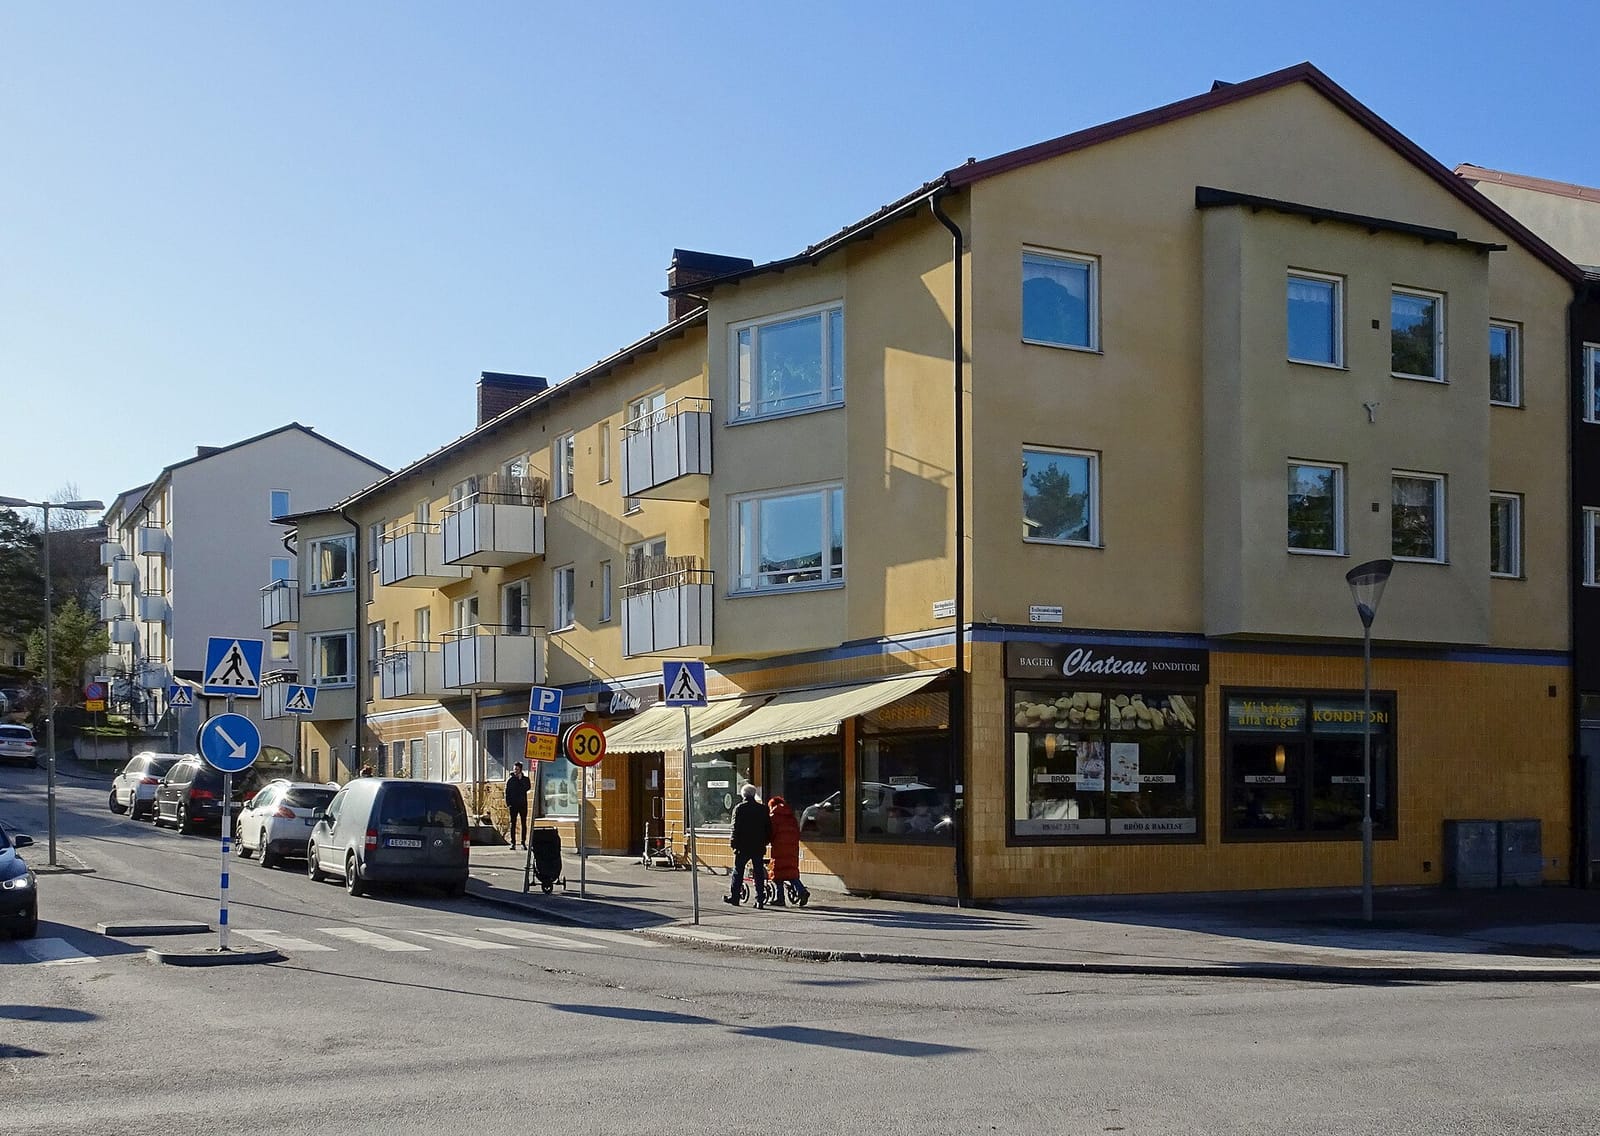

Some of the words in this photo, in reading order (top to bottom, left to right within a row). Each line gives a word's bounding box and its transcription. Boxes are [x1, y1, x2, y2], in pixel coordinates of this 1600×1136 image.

[1020, 657, 1053, 667] BAGERI
[1063, 648, 1148, 676] Chateau
[1152, 661, 1200, 672] KONDITORI
[539, 690, 555, 711] P
[1243, 701, 1256, 713] Vi
[1239, 714, 1261, 725] alla
[1265, 714, 1300, 728] dagar
[574, 733, 600, 756] 30
[1143, 775, 1164, 783] GLASS
[1144, 823, 1150, 831] &
